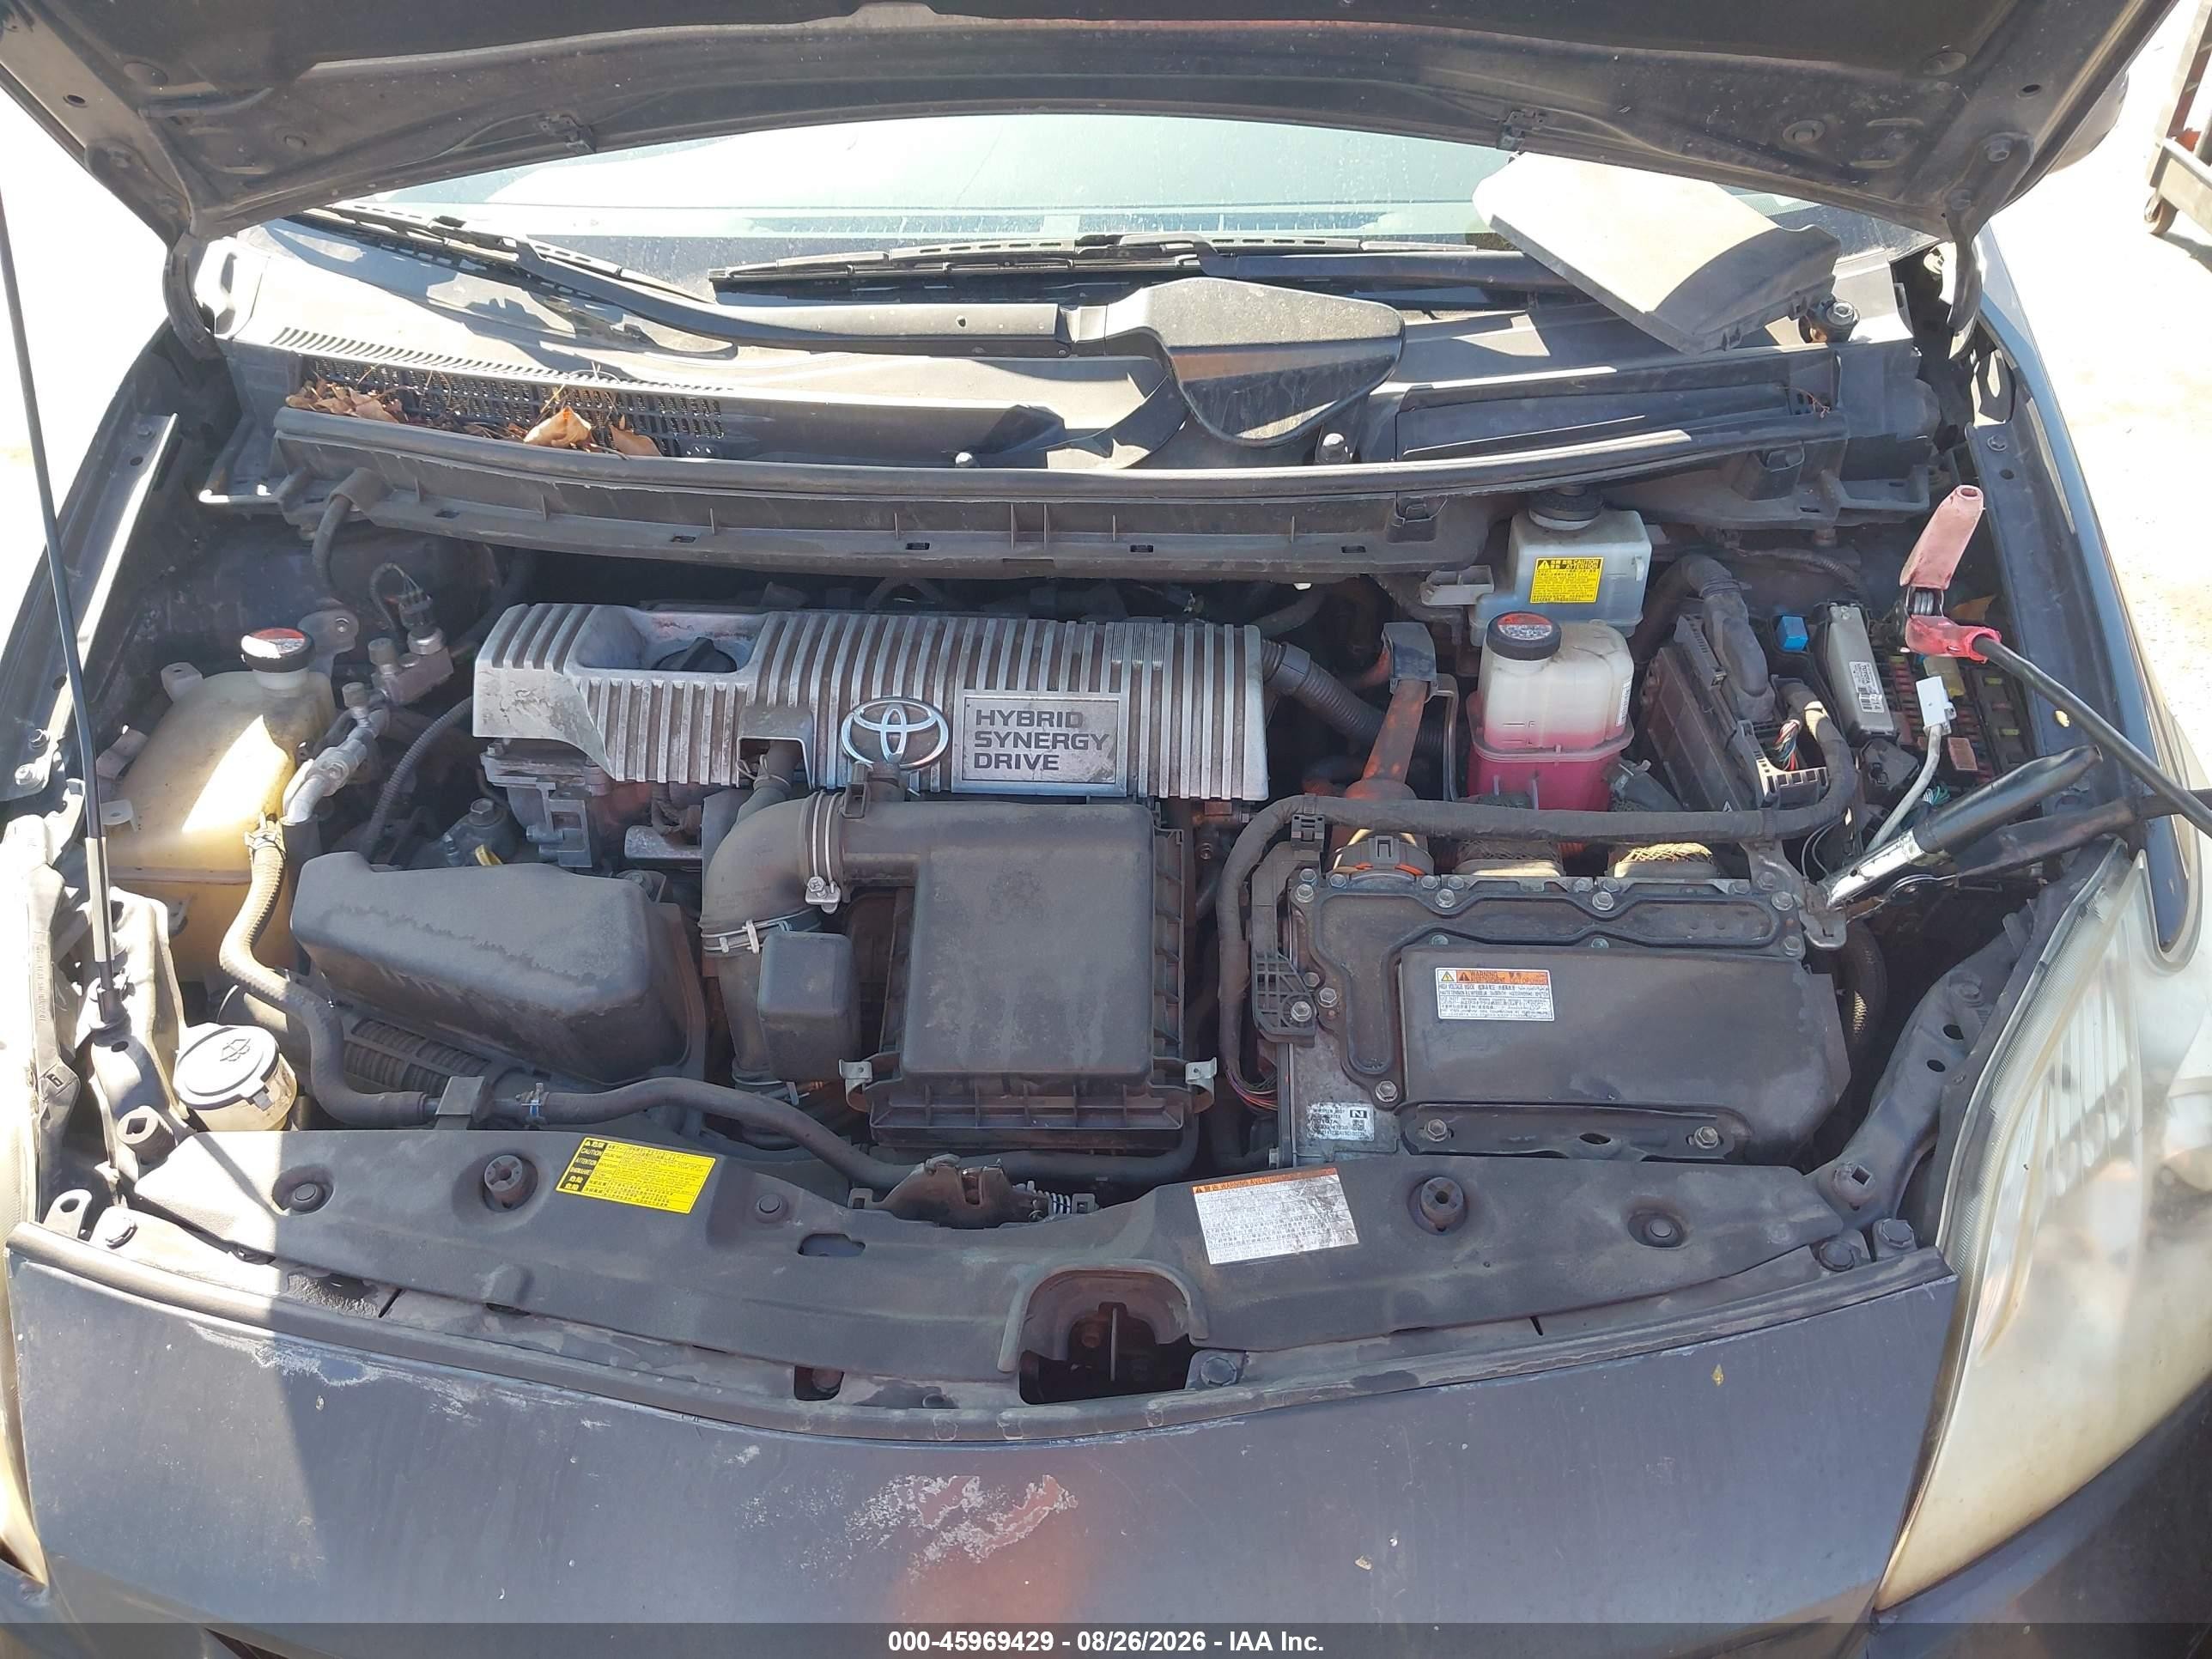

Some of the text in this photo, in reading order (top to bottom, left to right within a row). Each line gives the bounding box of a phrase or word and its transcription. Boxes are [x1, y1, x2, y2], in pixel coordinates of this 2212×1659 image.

[1861, 665, 1871, 684] TOYOTA
[975, 709, 1084, 729] HYBRID
[974, 730, 1110, 750] SYNERGY
[974, 752, 1060, 771] DRIVE
[574, 1157, 598, 1166] ATTENTION
[580, 1147, 603, 1157] CAUTION
